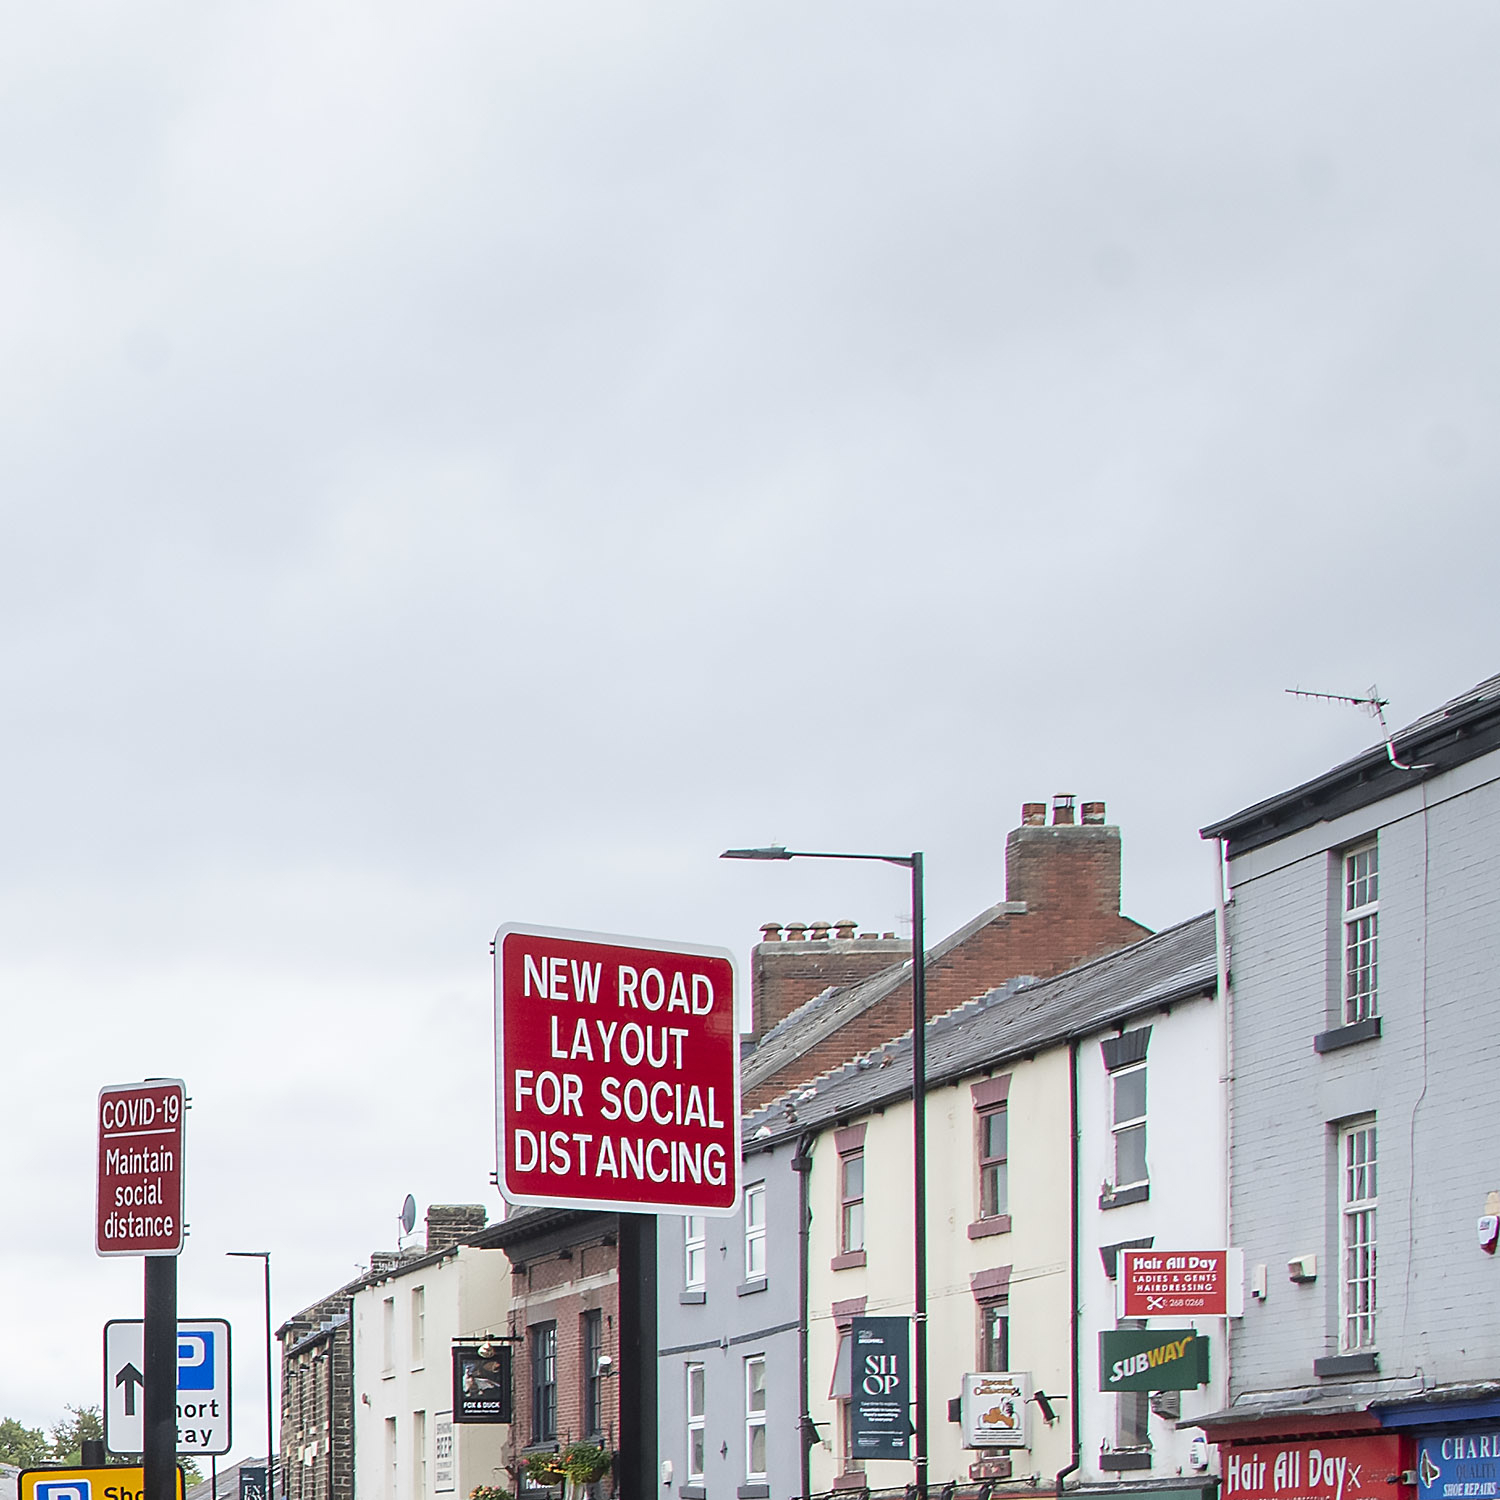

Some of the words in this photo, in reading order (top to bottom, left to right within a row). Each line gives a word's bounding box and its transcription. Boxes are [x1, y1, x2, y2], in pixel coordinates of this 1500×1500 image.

[523, 953, 602, 1004] NEW
[618, 964, 714, 1016] ROAD
[550, 1015, 689, 1070] LAYOUT
[102, 1095, 179, 1130] COVID-19
[514, 1069, 584, 1117] FOR
[600, 1076, 724, 1129] SOCIAL
[105, 1145, 174, 1176] Maintain
[514, 1128, 727, 1187] DISTANCING
[114, 1177, 163, 1207] social
[104, 1211, 174, 1239] distance
[1132, 1275, 1168, 1283] LADIES
[1184, 1274, 1217, 1282] GENTS
[1133, 1257, 1162, 1271] Hair
[1166, 1257, 1186, 1270] All
[1188, 1257, 1217, 1271] Day
[1136, 1284, 1213, 1292] HAIRDRESSING
[1109, 1336, 1194, 1383] SUBWAY
[1227, 1453, 1266, 1495] Hair
[1273, 1451, 1300, 1493] All
[1443, 1483, 1464, 1497] SHOE
[1464, 1482, 1497, 1496] REPAIRS
